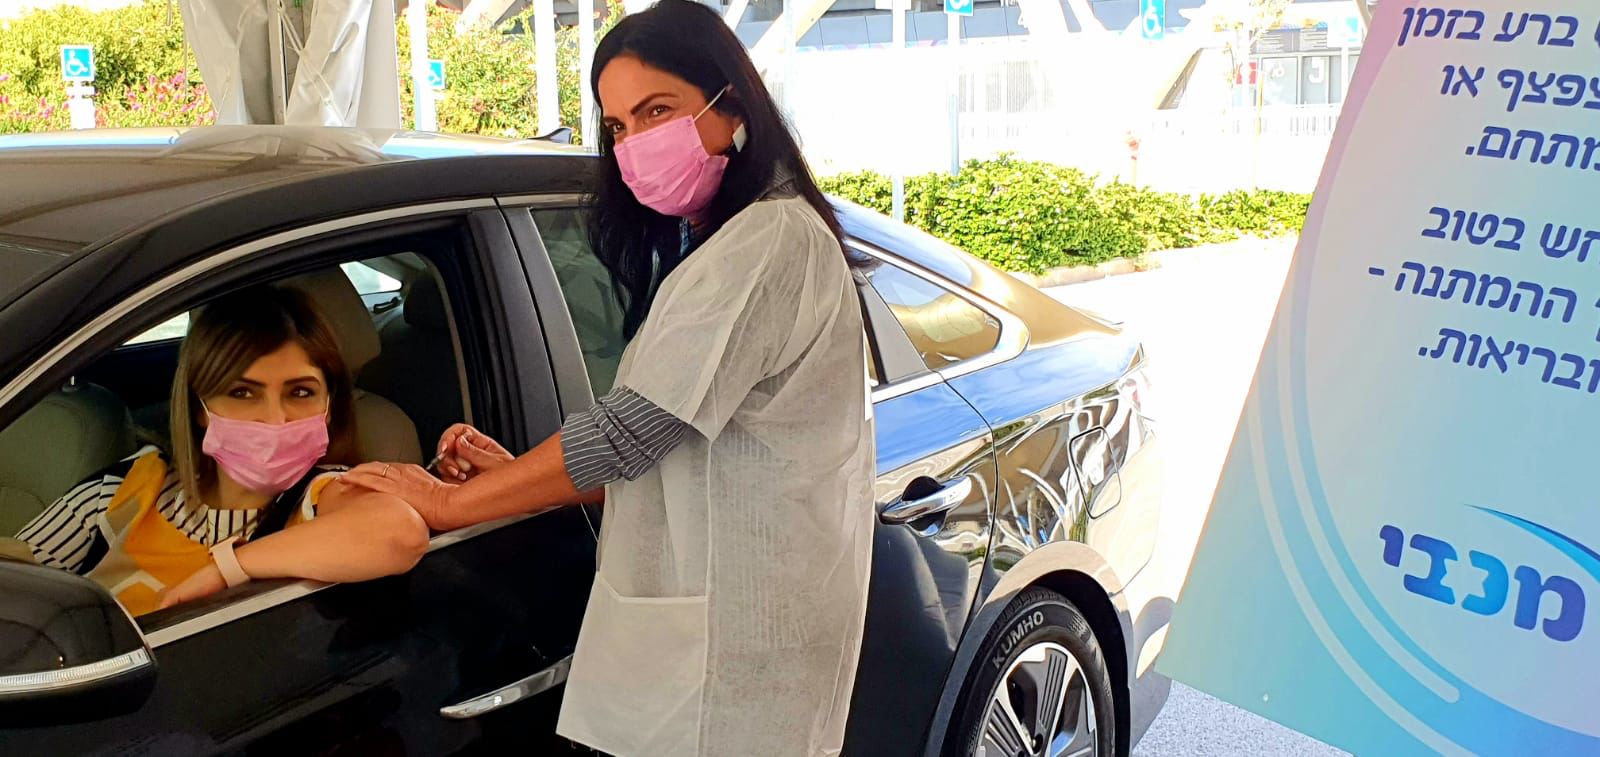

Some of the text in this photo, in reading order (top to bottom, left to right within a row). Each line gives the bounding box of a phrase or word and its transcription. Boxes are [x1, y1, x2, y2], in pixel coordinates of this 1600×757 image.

[1397, 7, 1486, 47] בזמן
[1493, 11, 1579, 48] ברע
[1440, 64, 1485, 98] או
[1421, 206, 1526, 251] בטוב
[1394, 261, 1578, 323] ההמתנה
[1379, 524, 1586, 642] מכבי
[992, 611, 1044, 669] KUMHO
